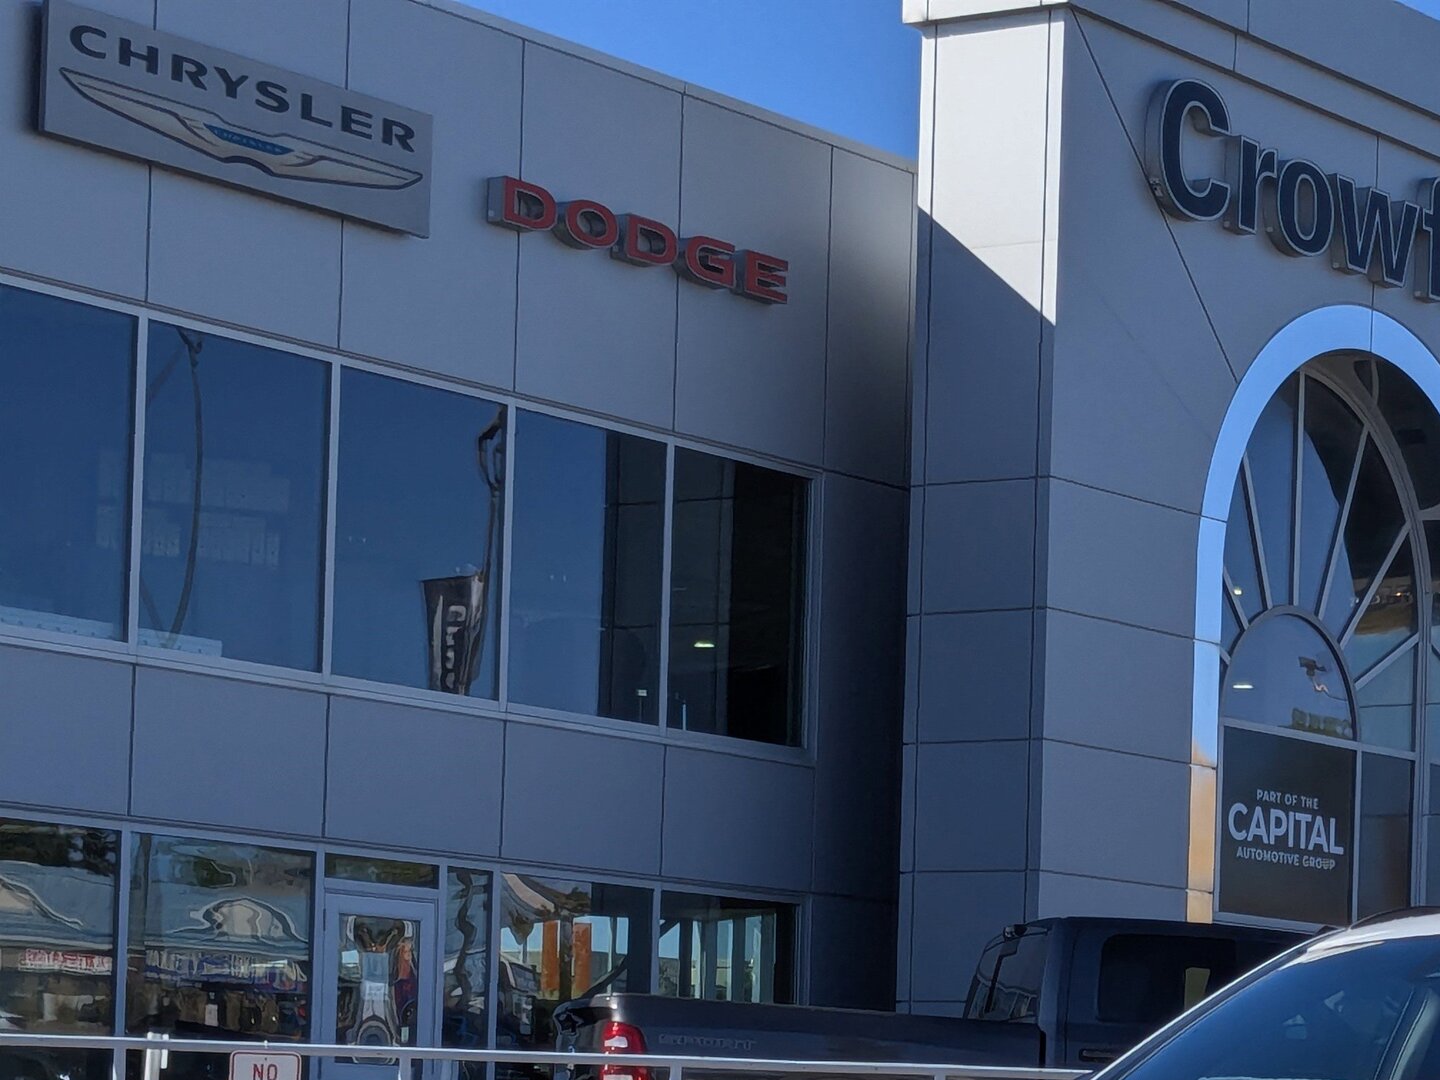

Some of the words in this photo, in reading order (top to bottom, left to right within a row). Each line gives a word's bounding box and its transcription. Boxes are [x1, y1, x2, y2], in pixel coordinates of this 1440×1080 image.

[69, 24, 416, 153] CHRYSLER
[500, 175, 789, 305] DODGE
[1256, 789, 1282, 804] PART
[1284, 793, 1298, 807] OF
[1300, 795, 1320, 810] THE
[1228, 802, 1345, 855] CAPITAL
[1236, 846, 1300, 866] AUTOMOTIVE
[1302, 855, 1336, 871] GROUP
